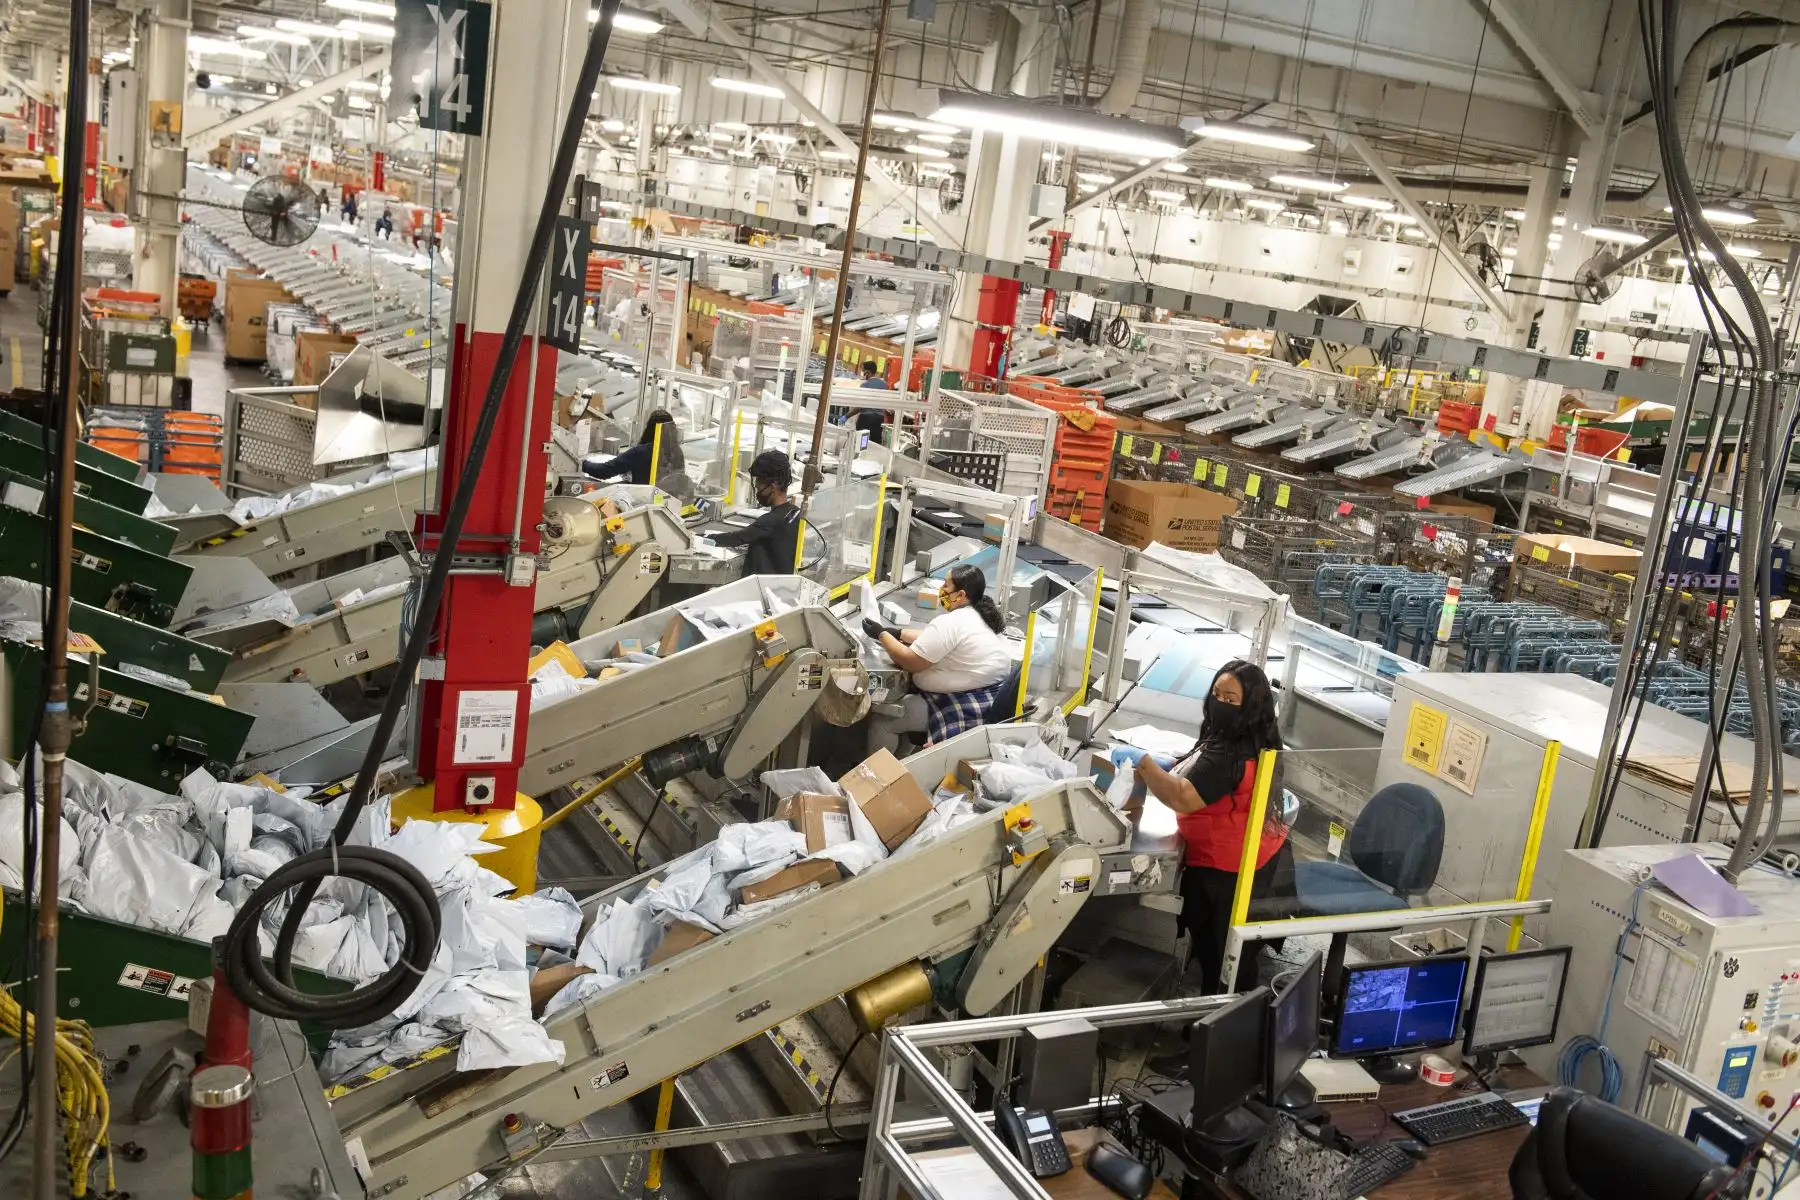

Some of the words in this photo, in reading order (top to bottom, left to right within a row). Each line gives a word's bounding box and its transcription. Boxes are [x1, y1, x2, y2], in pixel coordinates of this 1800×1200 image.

[423, 3, 469, 59] X
[412, 68, 472, 123] 14
[560, 227, 580, 280] X
[552, 290, 578, 343] 14
[1576, 331, 1585, 343] Z
[1573, 343, 1585, 355] 13
[1616, 812, 1652, 832] LOCKHEED
[1654, 830, 1679, 844] MARTI
[1591, 900, 1632, 923] LOCKHEED
